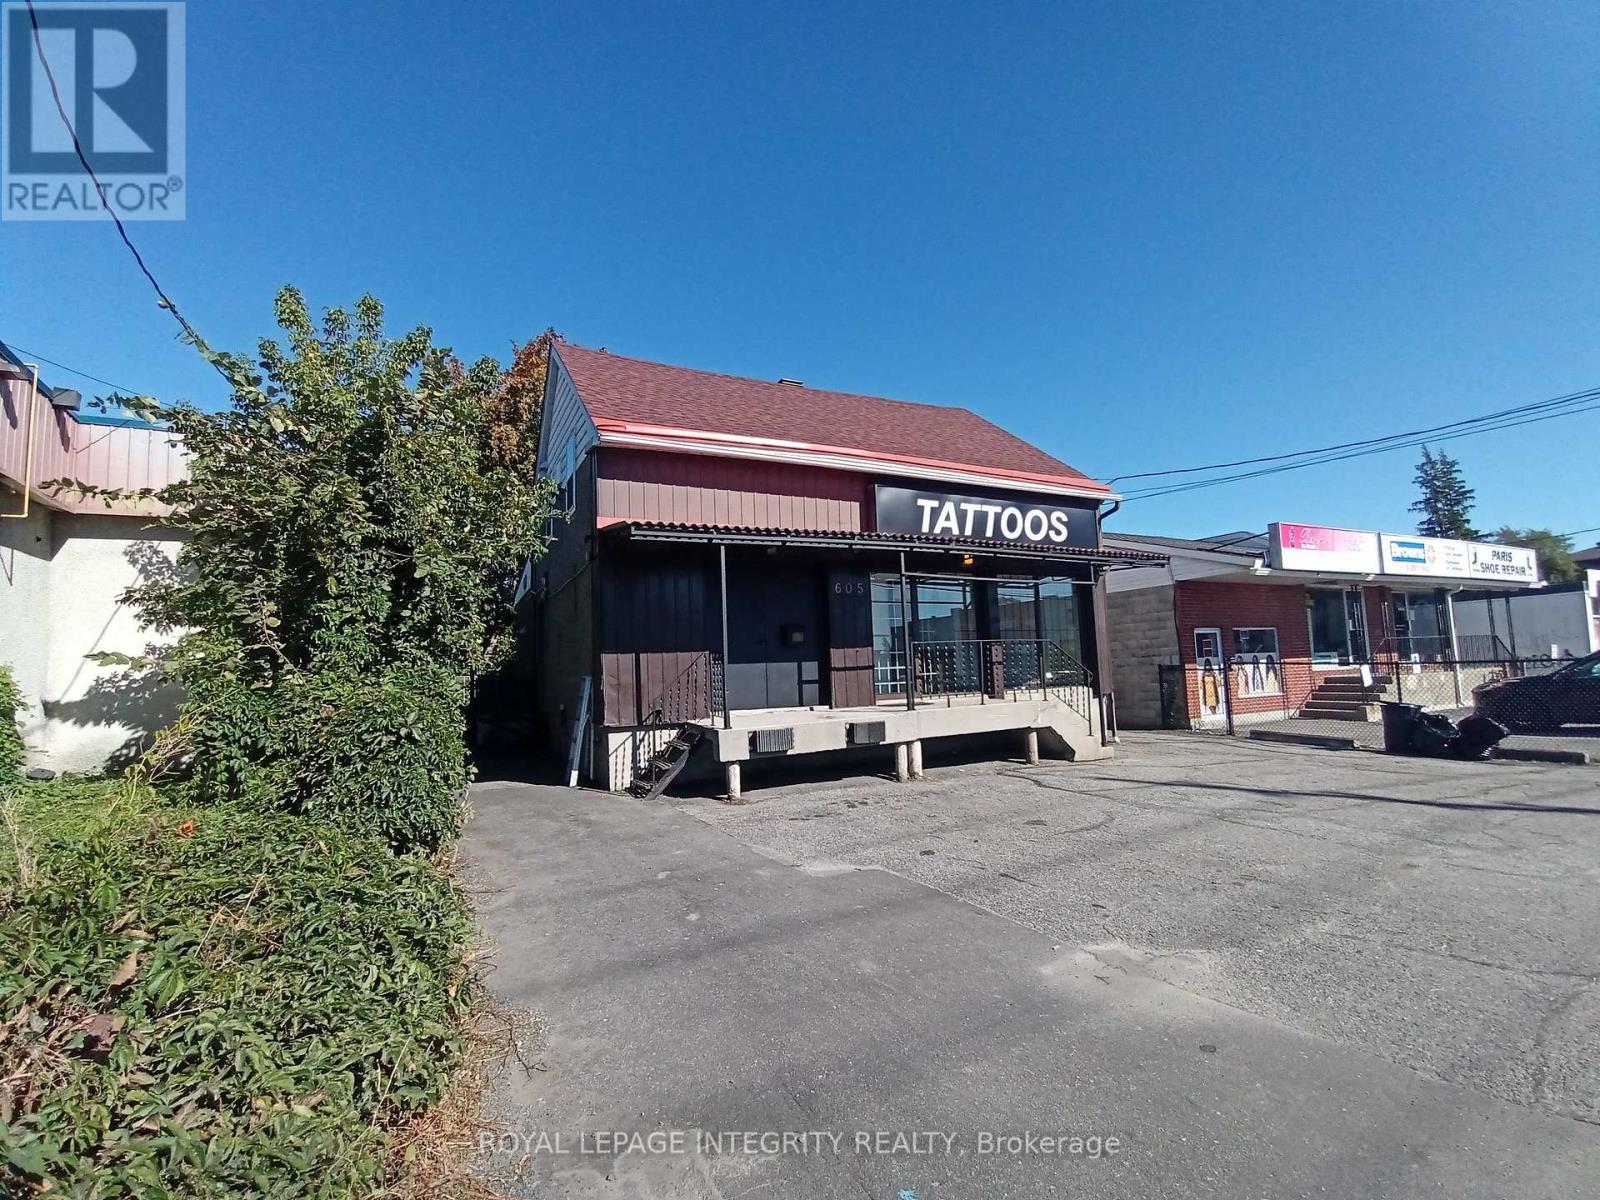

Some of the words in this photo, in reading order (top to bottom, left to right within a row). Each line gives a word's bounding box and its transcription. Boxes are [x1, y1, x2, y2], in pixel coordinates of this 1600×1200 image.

[916, 498, 1069, 543] TATTOOS
[1491, 550, 1513, 562] PARIS
[1480, 562, 1500, 574] SHOE
[1501, 564, 1526, 576] REPAIR
[834, 582, 864, 594] 605
